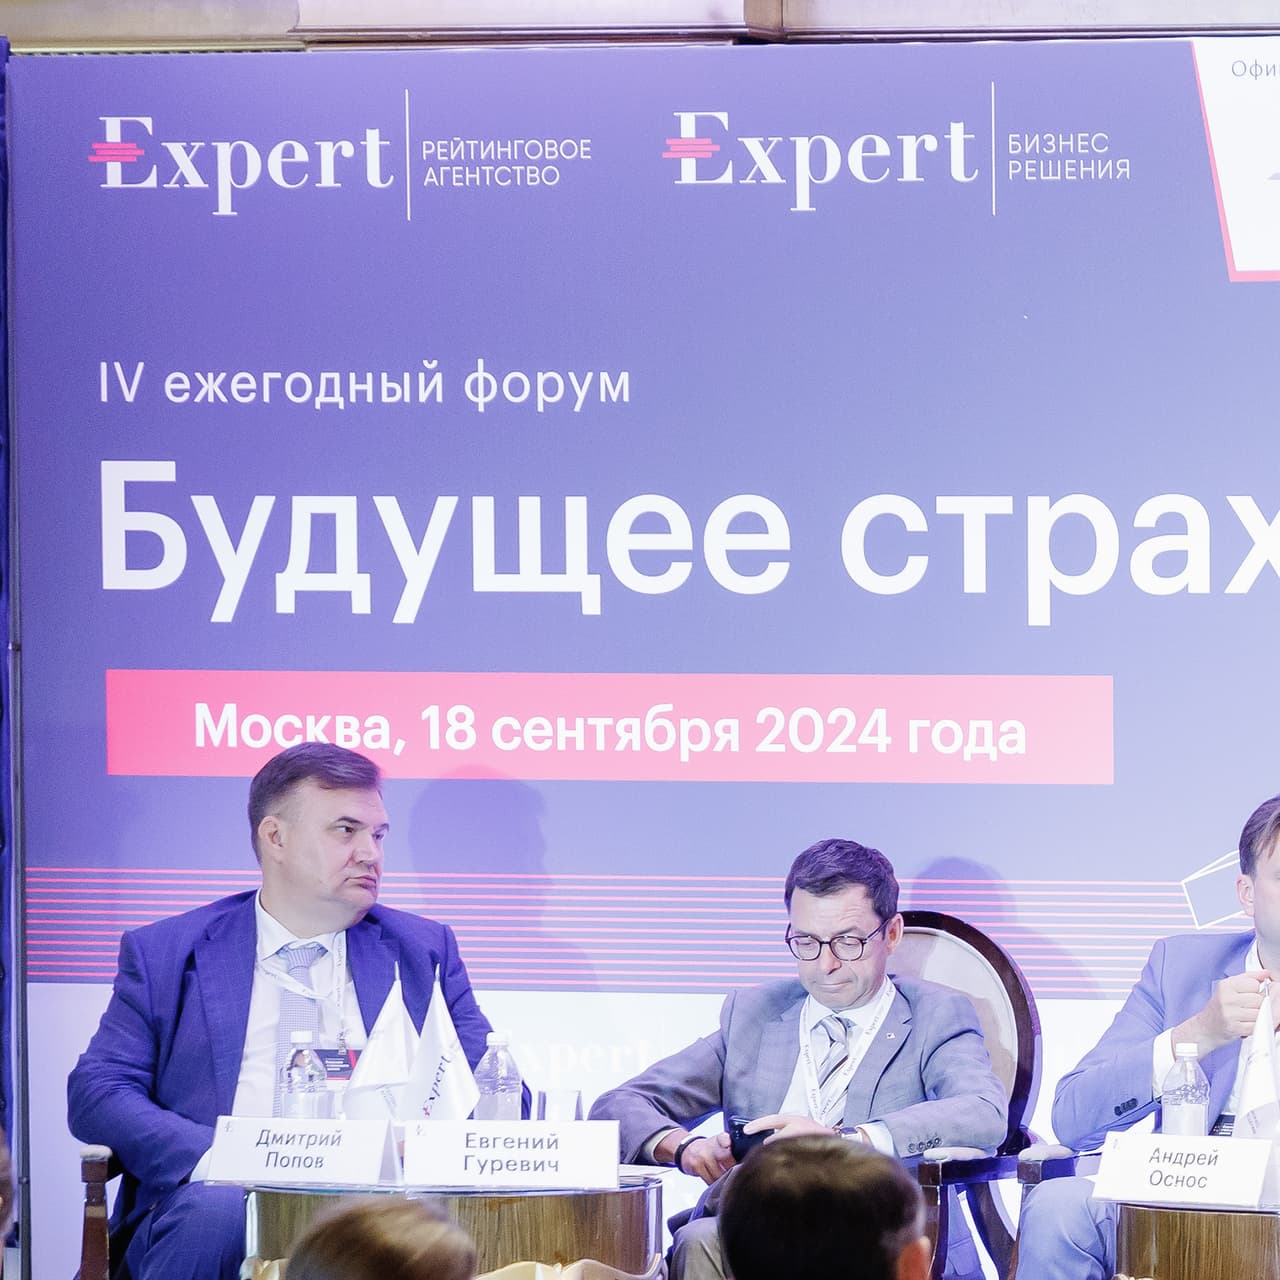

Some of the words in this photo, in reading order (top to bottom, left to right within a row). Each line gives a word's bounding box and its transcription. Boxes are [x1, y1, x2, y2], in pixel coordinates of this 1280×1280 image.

[421, 136, 592, 162] РЕЙТИНГОВОЕ
[1007, 132, 1110, 155] БИЗНЕС
[90, 116, 394, 216] Expert
[662, 111, 979, 212] Expert
[1007, 158, 1131, 181] РЕШЕНИЯ
[423, 164, 561, 188] АГЕНТСТВО
[99, 361, 145, 403] IV
[163, 358, 445, 412] ежегодный
[463, 358, 631, 413] форум
[100, 459, 793, 624] Будущее
[194, 702, 408, 757] Москва,
[420, 703, 477, 752] 18
[491, 704, 740, 762] сентября
[755, 706, 893, 756] 2024
[908, 719, 1027, 762] года
[255, 1128, 343, 1149] Дмитрий
[464, 1132, 560, 1150] Евгений
[264, 1151, 324, 1170] Попов
[463, 1154, 560, 1175] Гуревич
[1148, 1147, 1219, 1169] Андрей
[1149, 1169, 1208, 1189] Оснос
